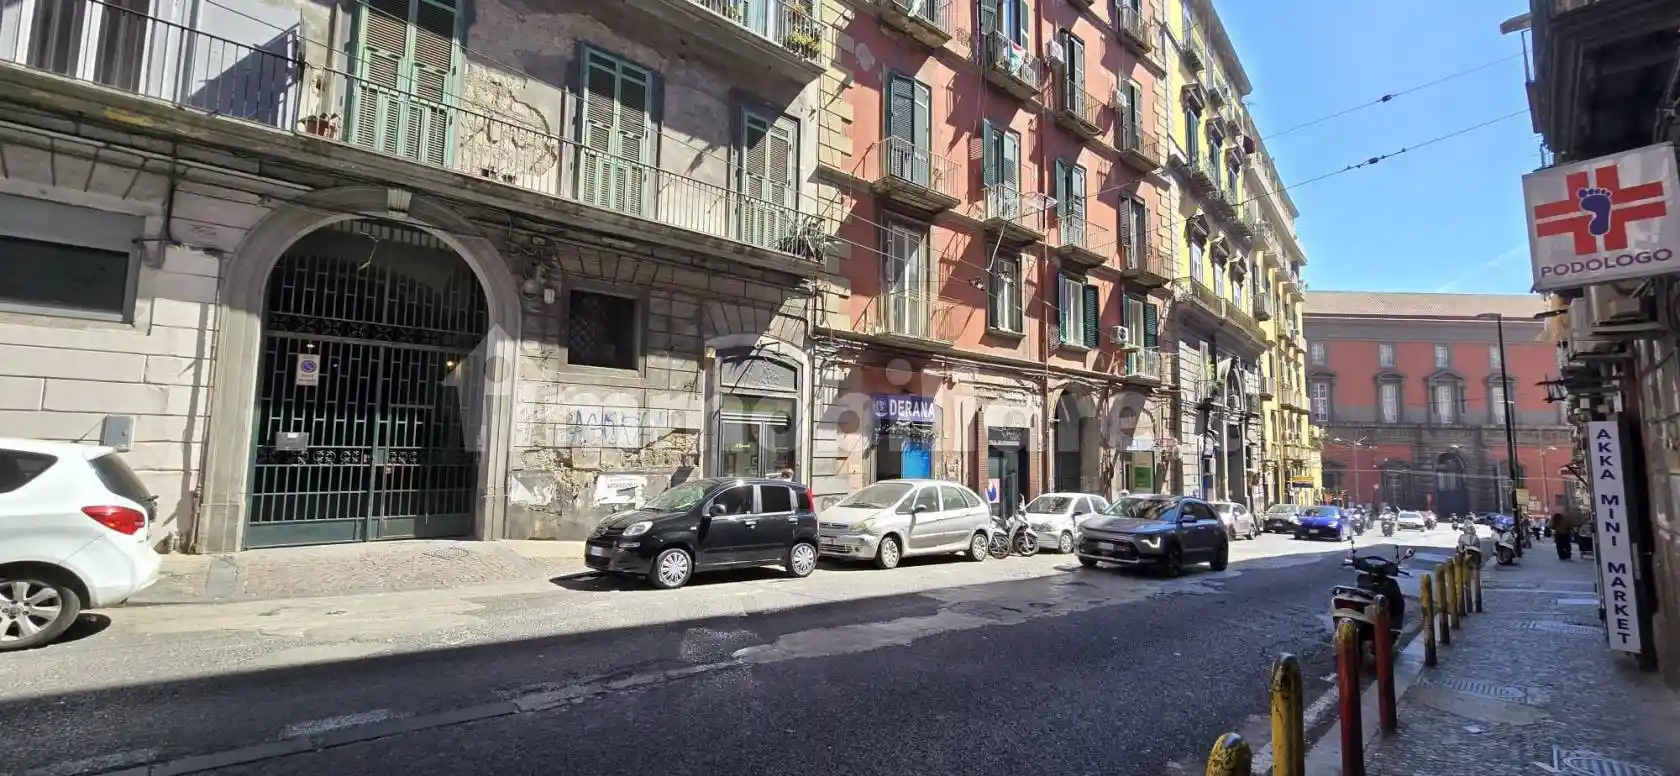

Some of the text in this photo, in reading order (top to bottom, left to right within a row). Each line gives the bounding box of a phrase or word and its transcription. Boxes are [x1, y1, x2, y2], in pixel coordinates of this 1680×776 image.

[1541, 248, 1673, 278] PODOLOGO
[889, 399, 935, 418] DERANA
[1596, 428, 1631, 644] AKKA MINI MARKET
